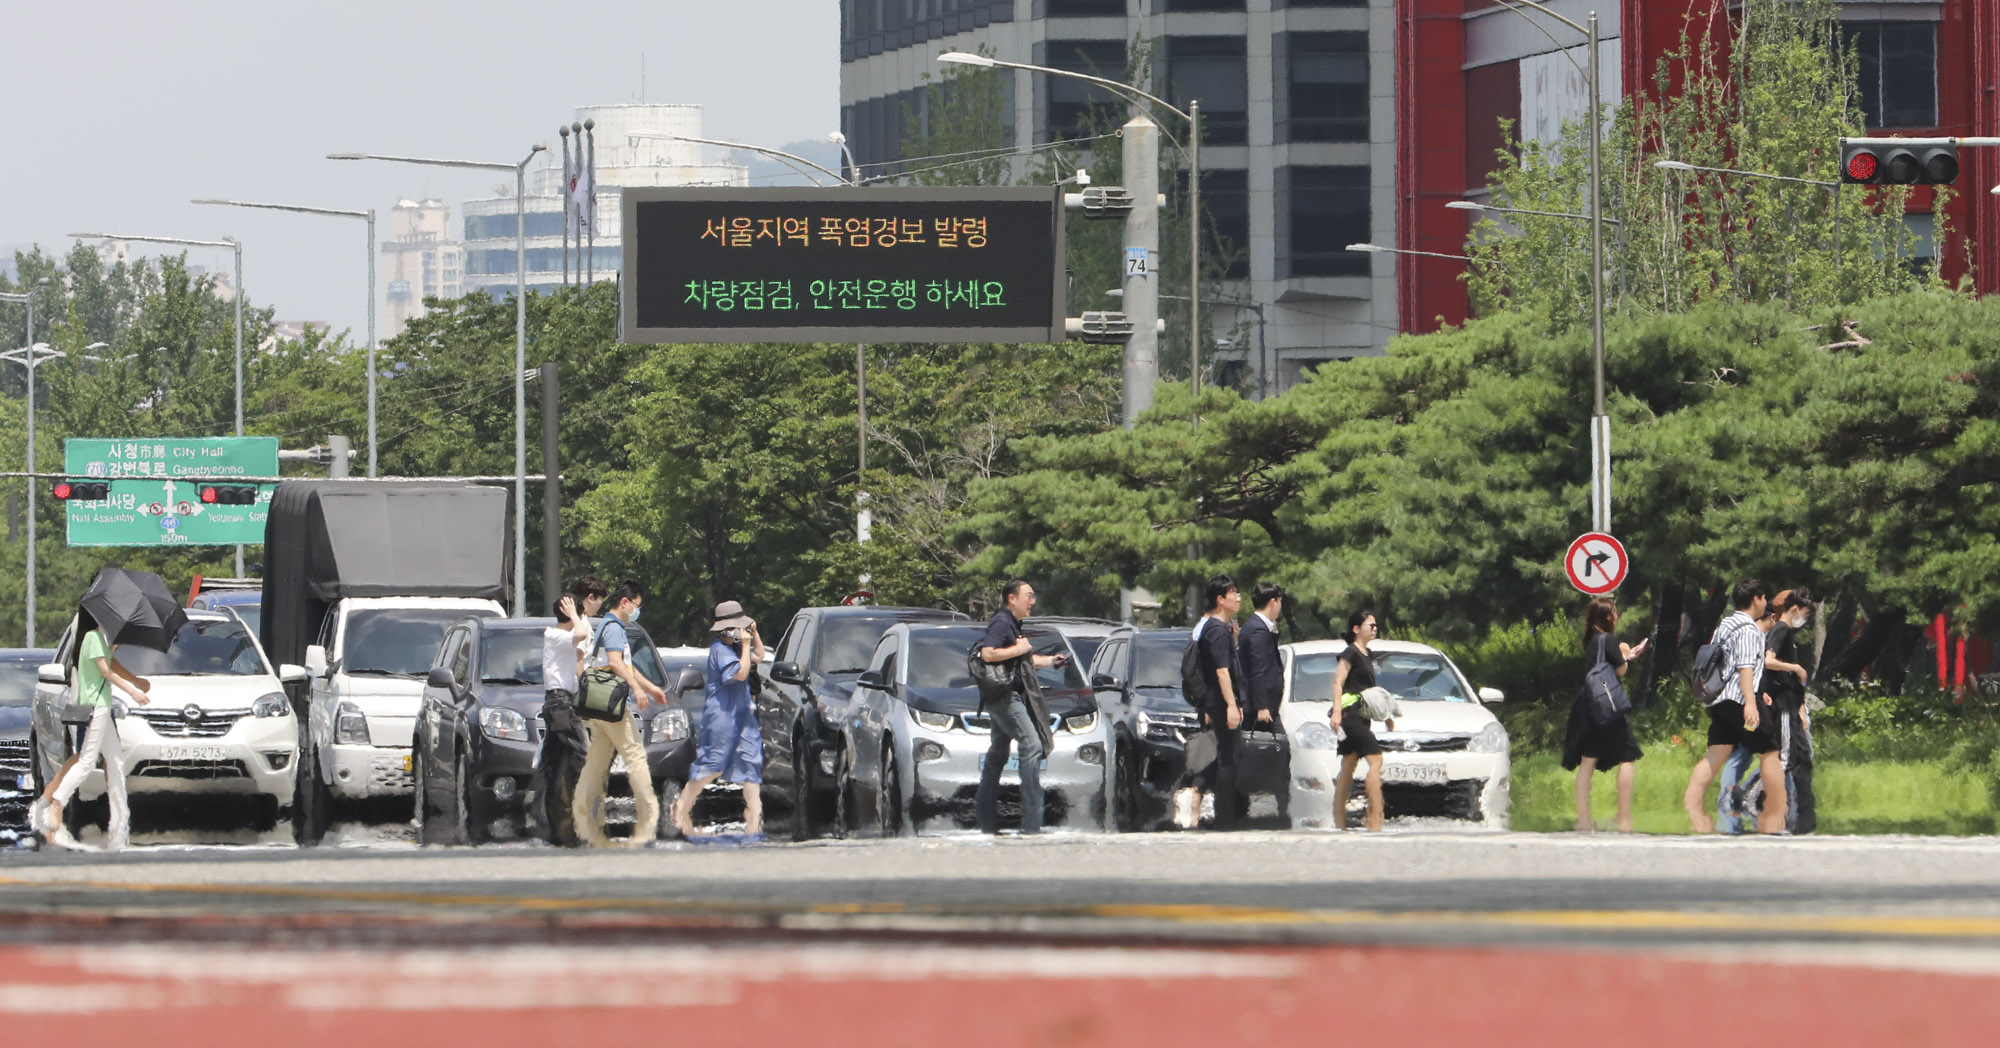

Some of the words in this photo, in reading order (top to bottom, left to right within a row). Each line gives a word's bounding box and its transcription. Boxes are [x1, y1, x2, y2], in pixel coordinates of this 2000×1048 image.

[700, 216, 808, 247] 서울지역
[818, 216, 925, 248] 폭염경보
[934, 216, 987, 248] 발령
[1129, 259, 1146, 272] 74
[684, 279, 800, 312] 차량점검,
[810, 279, 916, 310] 안전운행
[925, 279, 1007, 310] 하세요
[173, 447, 196, 459] City
[201, 447, 223, 457] Hall
[108, 461, 168, 477] 강변북로
[192, 747, 221, 759] 5273
